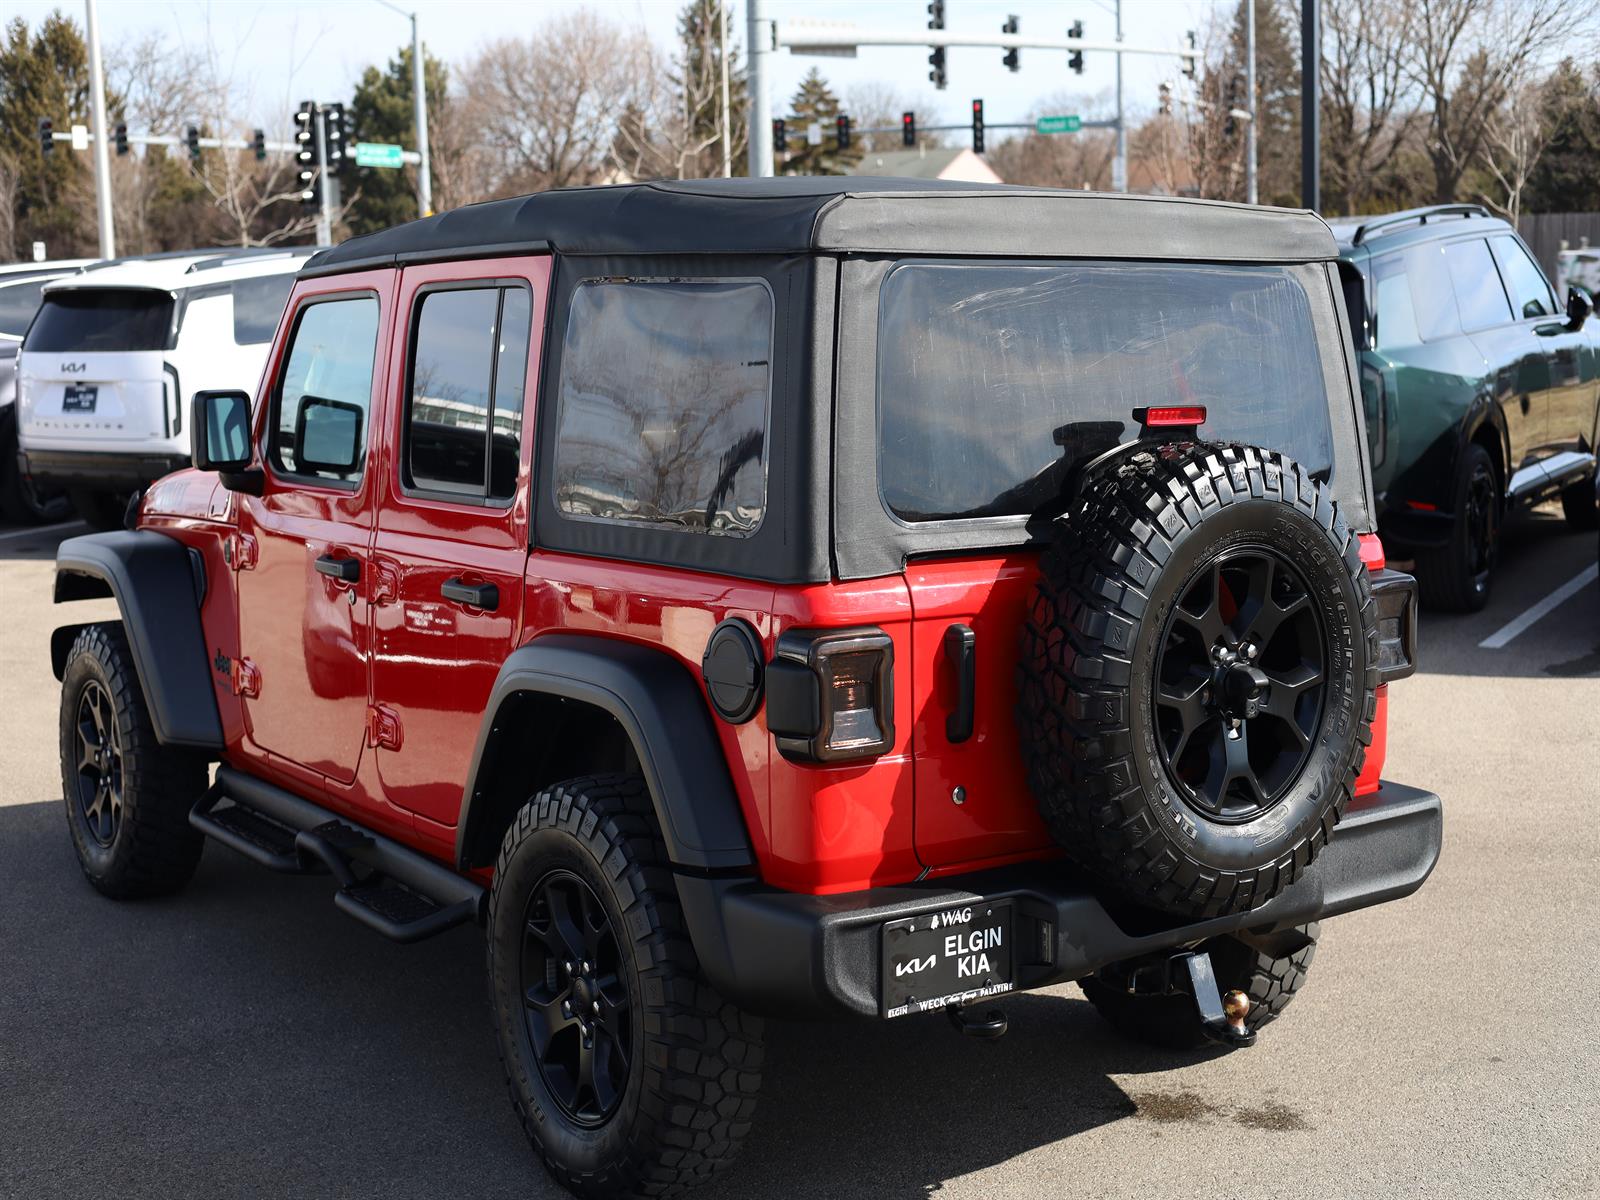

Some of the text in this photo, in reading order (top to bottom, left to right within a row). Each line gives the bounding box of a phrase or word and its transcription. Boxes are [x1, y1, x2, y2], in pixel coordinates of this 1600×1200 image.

[941, 907, 972, 927] WAG
[944, 926, 1002, 957] ELGIN
[957, 953, 991, 978] KIA
[887, 1006, 909, 1019] ELGIN
[919, 996, 946, 1012] WECK
[980, 982, 1013, 997] PALATINE
